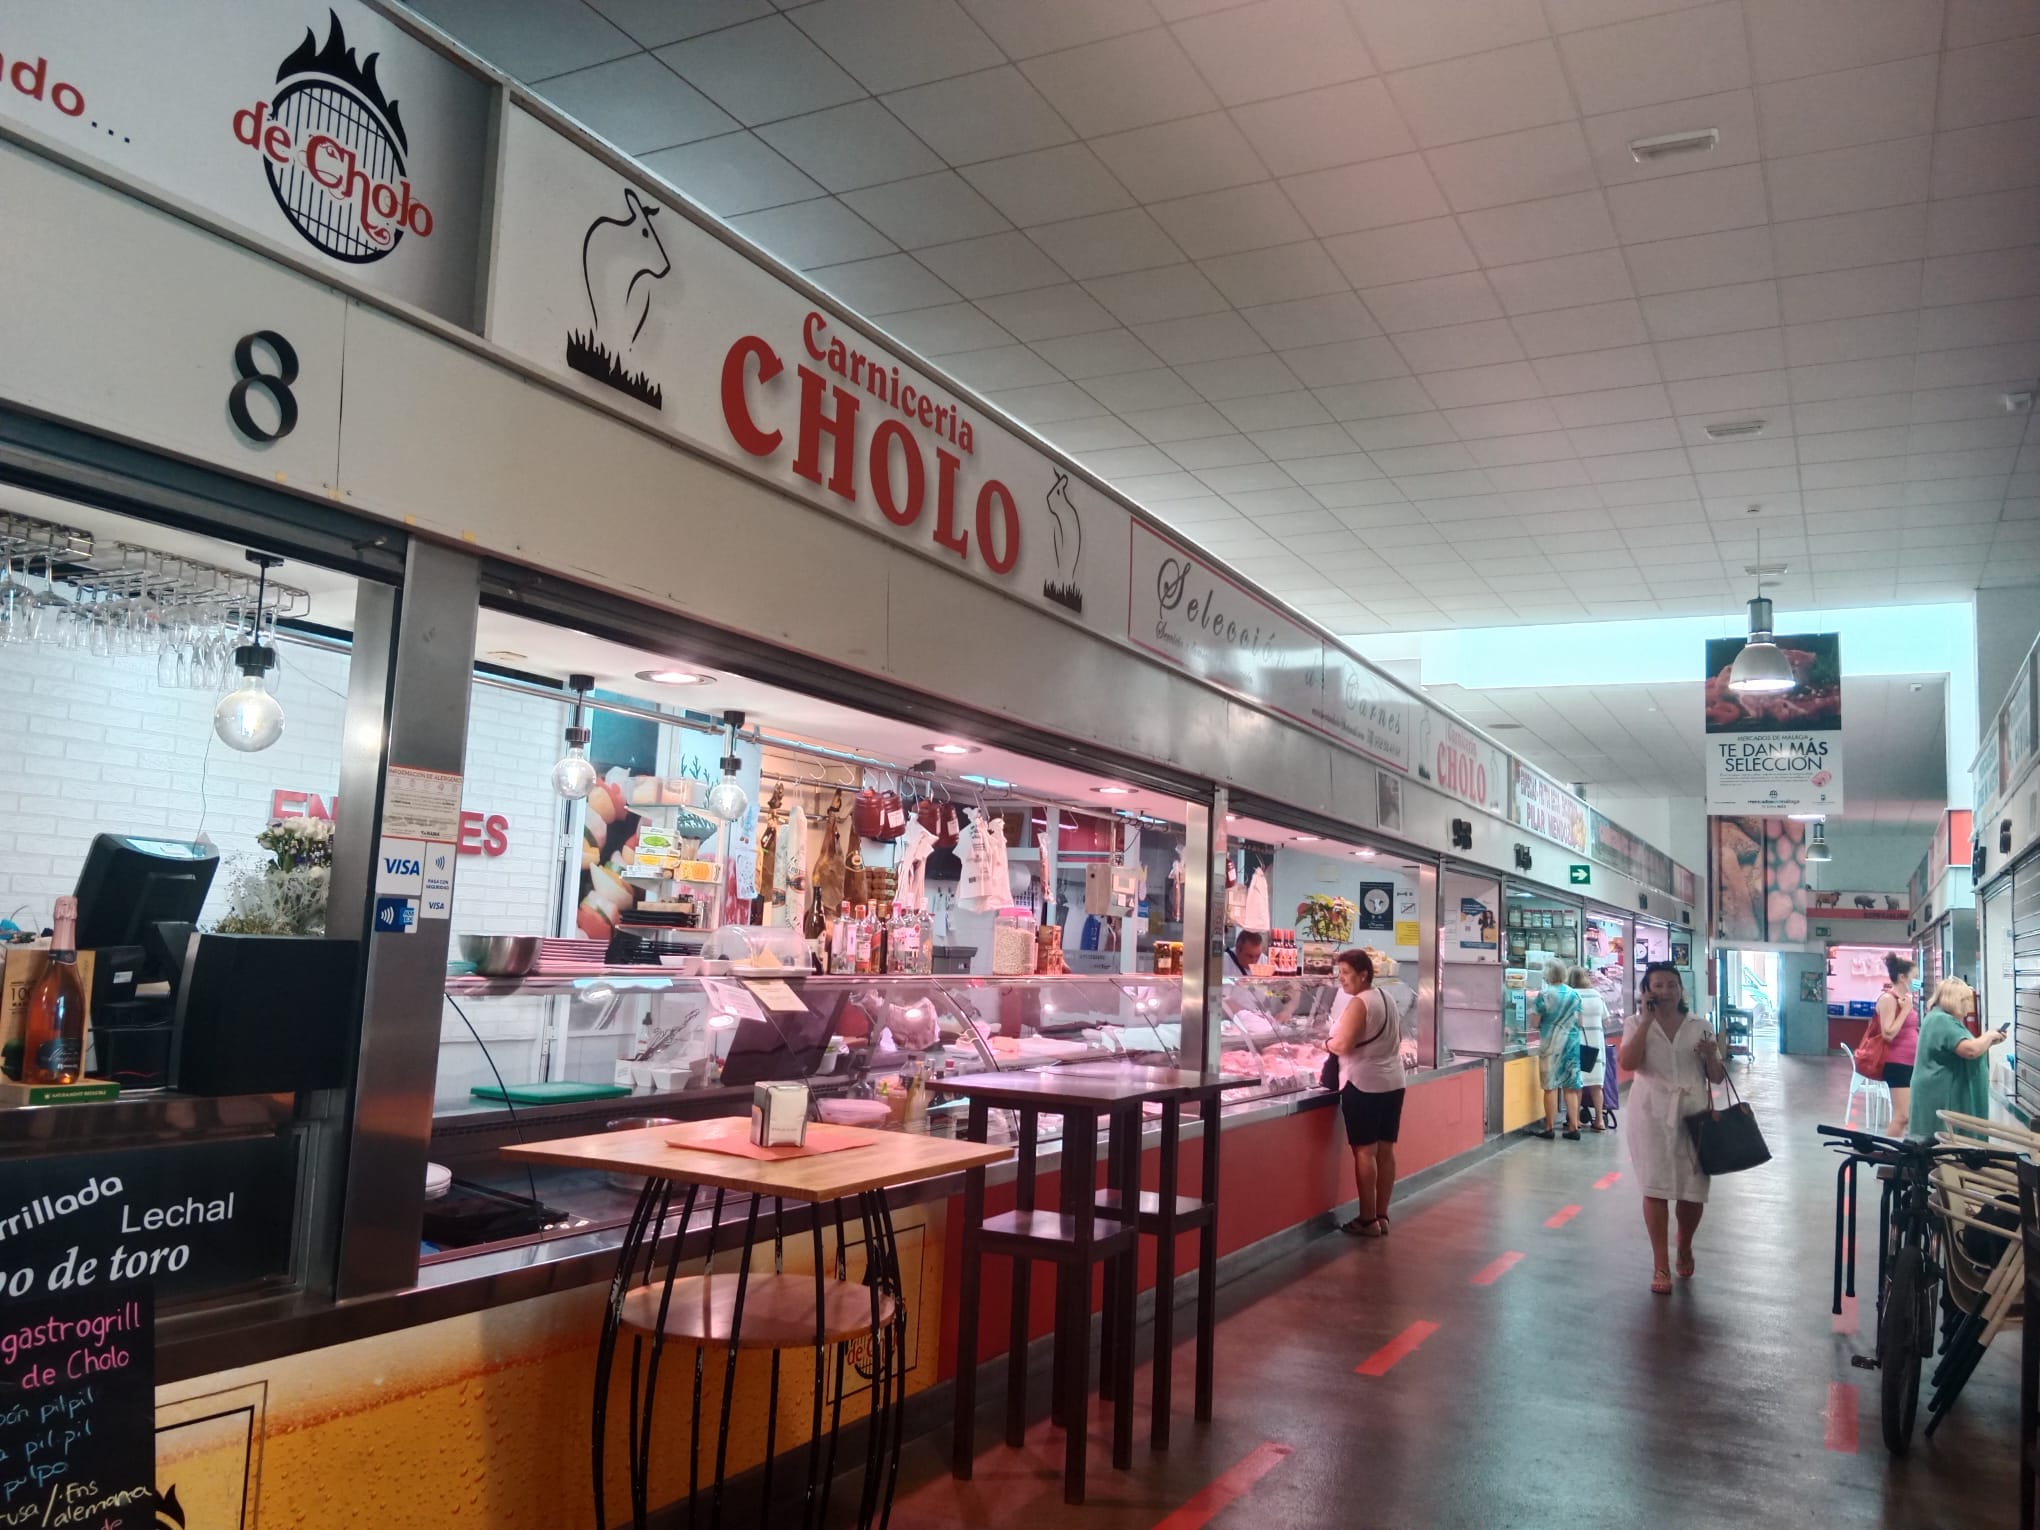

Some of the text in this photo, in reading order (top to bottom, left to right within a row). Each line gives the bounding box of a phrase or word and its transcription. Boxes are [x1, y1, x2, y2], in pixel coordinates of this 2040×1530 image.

[0, 53, 131, 144] do...
[232, 100, 433, 246] de Cholo
[229, 330, 299, 442] 8
[803, 312, 974, 454] Carniceria
[721, 335, 1020, 575] CHOLO
[1437, 741, 1486, 804] CHOLO
[1719, 737, 1828, 757] TE DAN MÁS
[1725, 755, 1822, 772] SELECCIÓN
[384, 857, 420, 876] VISA
[428, 901, 445, 910] VISA
[121, 1192, 235, 1233] Lechal
[47, 1245, 98, 1292] de
[109, 1244, 190, 1281] toro
[1, 1302, 140, 1365] gastrogrill
[22, 1345, 129, 1390] de Cholo
